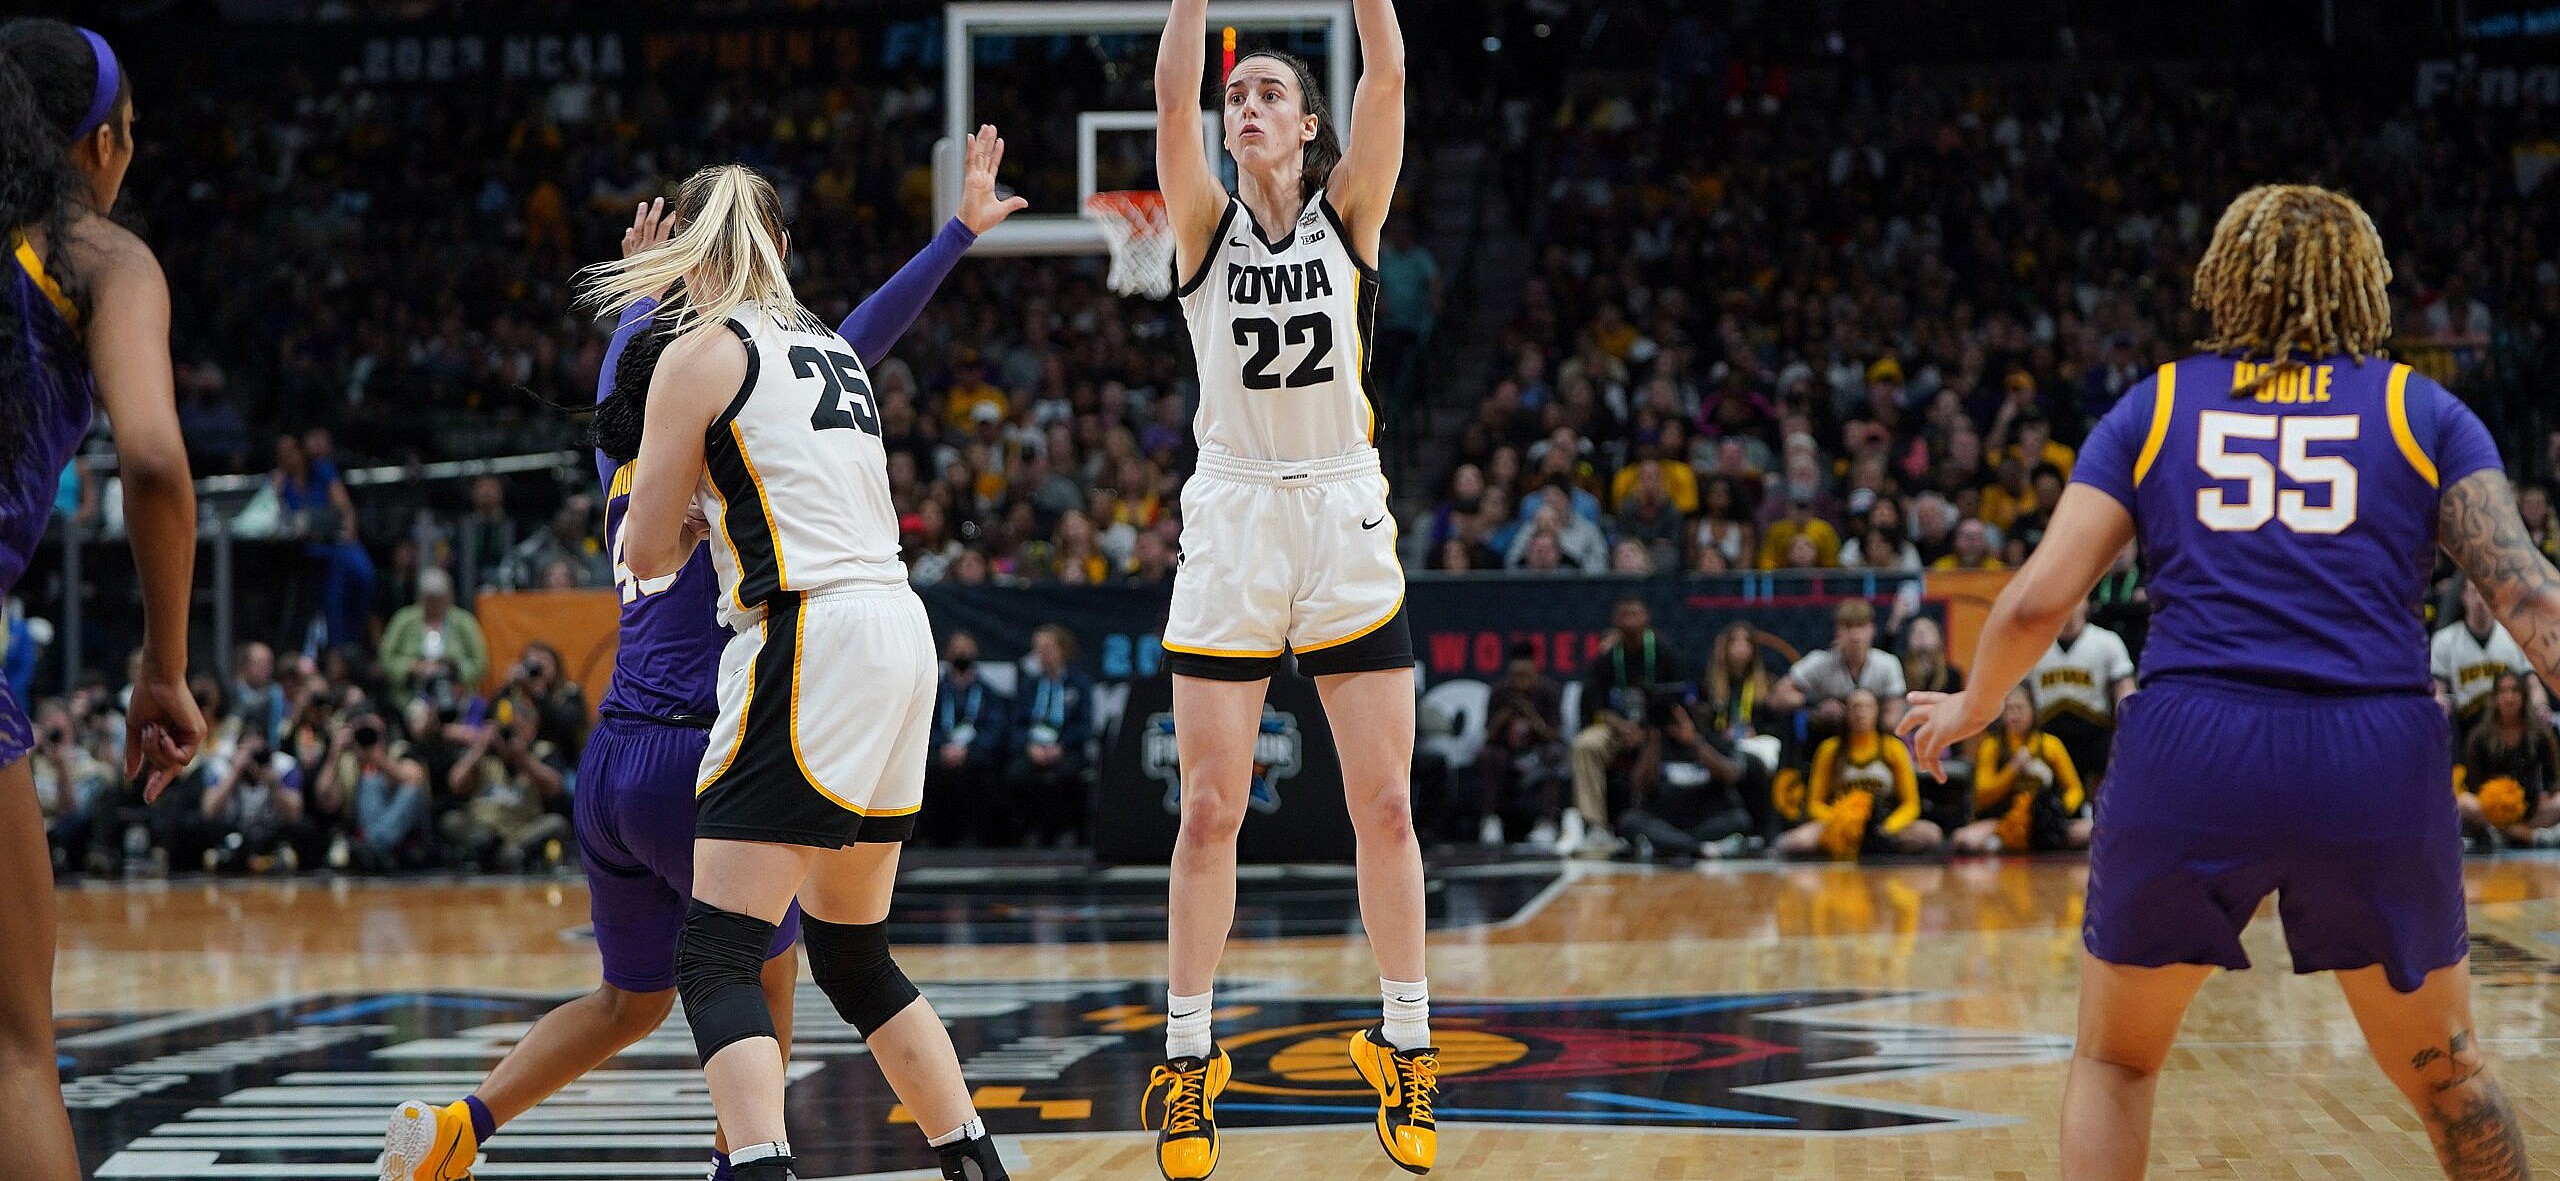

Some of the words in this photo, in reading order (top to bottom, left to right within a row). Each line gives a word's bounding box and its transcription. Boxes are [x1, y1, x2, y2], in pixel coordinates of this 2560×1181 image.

[1228, 258, 1332, 305] IOWA
[1231, 311, 1335, 390] 22
[2232, 361, 2335, 404] POOLE
[788, 345, 881, 438] 25
[2196, 409, 2361, 535] 55
